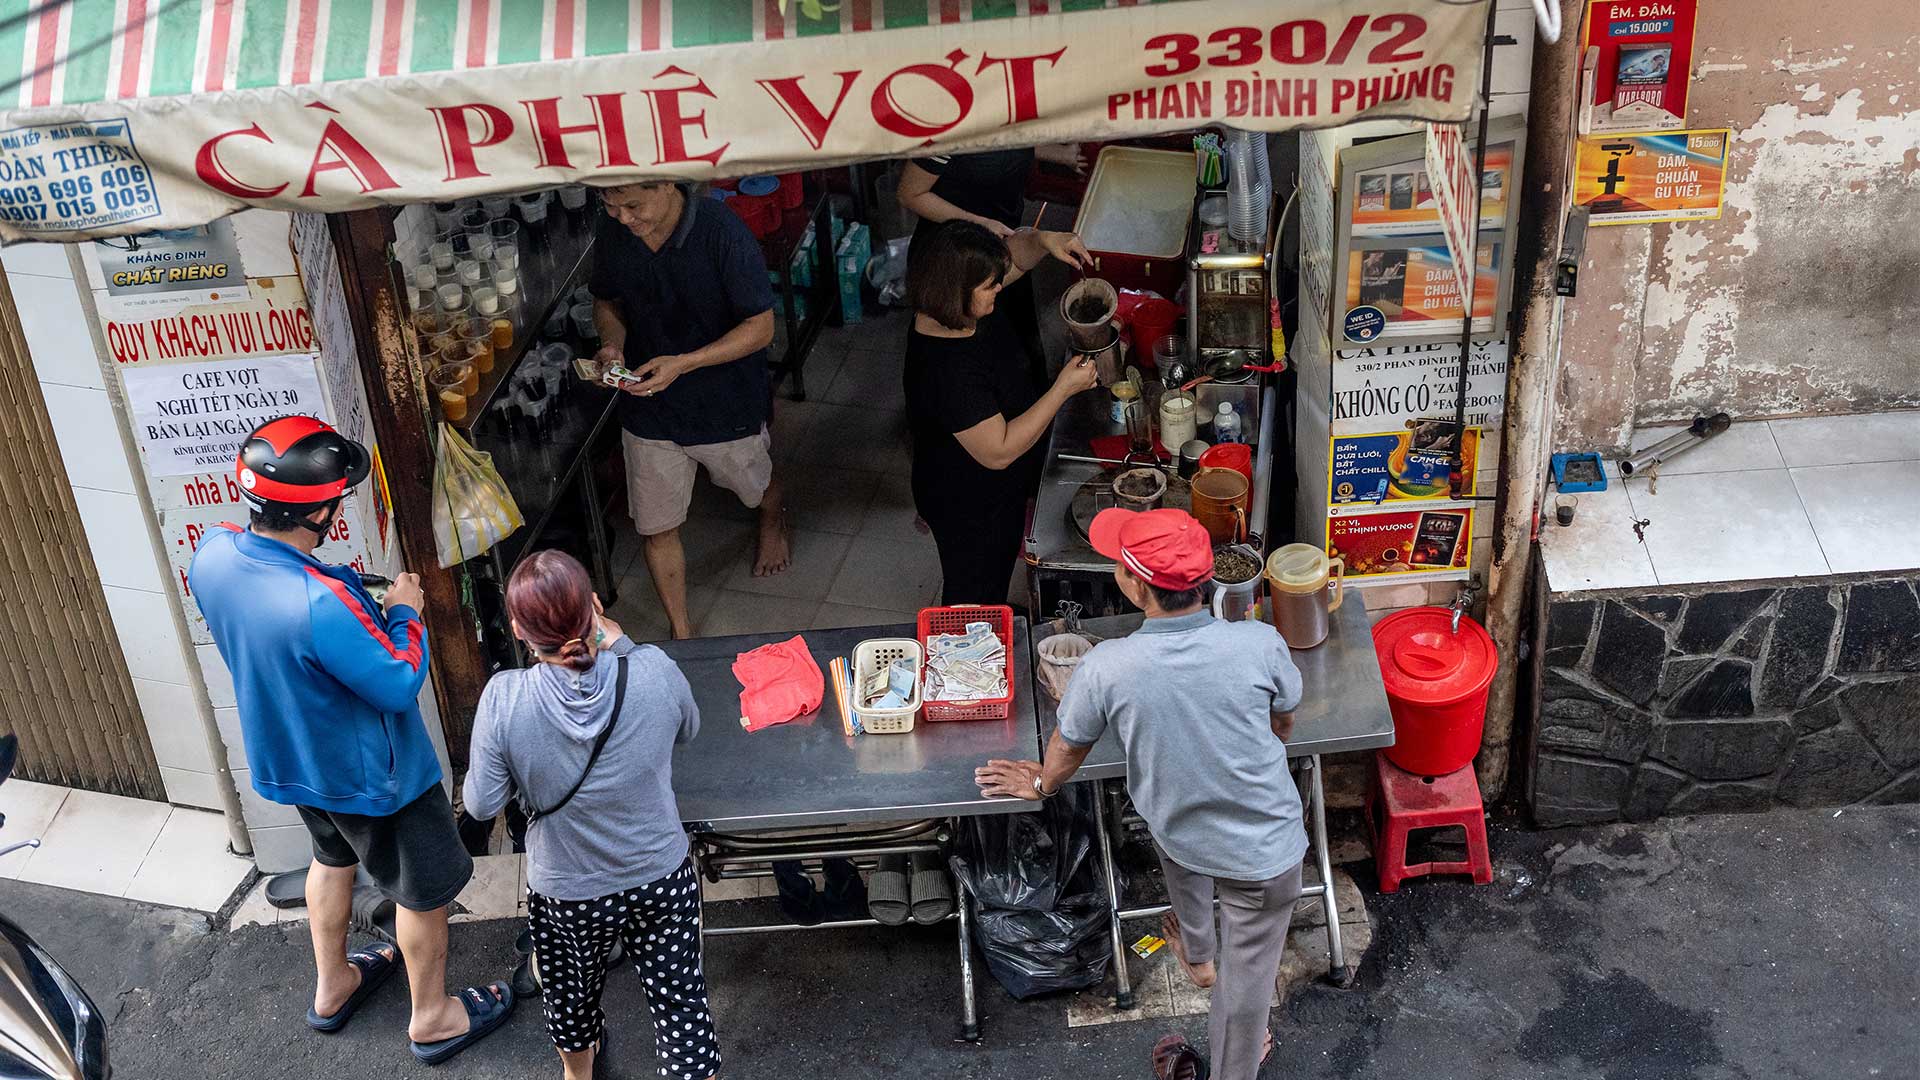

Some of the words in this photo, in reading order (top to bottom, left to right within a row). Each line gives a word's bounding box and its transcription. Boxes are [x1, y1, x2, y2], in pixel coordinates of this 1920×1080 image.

[1610, 5, 1635, 19] ÊM.
[1639, 2, 1676, 19] ĐẬM.
[1144, 13, 1428, 78] 330/2
[1108, 86, 1212, 121] PHAN
[1225, 71, 1317, 118] ĐÌNH
[1331, 63, 1455, 115] PHÙNG
[1617, 89, 1662, 108] MARLBORO
[195, 101, 402, 199] CÀ
[427, 65, 730, 182] PHÊ
[755, 46, 1068, 150] VỢT
[1658, 153, 1689, 170] ĐẬM.
[48, 176, 93, 200] 696
[101, 165, 145, 189] 406
[1655, 186, 1672, 199] GU
[1675, 183, 1702, 199] VIỆT
[56, 196, 97, 218] 015
[104, 184, 151, 211] 005
[168, 262, 228, 282] RIÊNG
[1424, 299, 1440, 309] GU
[1443, 296, 1461, 309] VIỆ
[220, 309, 258, 354] VUI
[256, 298, 313, 352] LÒNG
[1355, 362, 1381, 373] 330/2
[1384, 358, 1416, 370] PHAN
[1418, 355, 1447, 367] ĐÌNH
[1451, 353, 1491, 363] PNG
[182, 371, 224, 390] CAFE
[226, 367, 260, 389] VỢT
[156, 393, 199, 417] NGHỈ
[200, 390, 230, 412] TẾT
[231, 387, 279, 411] NGÀY
[283, 389, 299, 406] 30
[1334, 378, 1400, 420] KHÔNG
[1405, 374, 1430, 414] CÓ
[147, 419, 181, 441] BÁN
[184, 421, 209, 441] LẠI
[210, 413, 258, 436] NGÀY
[173, 443, 195, 456] KÍNH
[195, 442, 220, 454] CHÚC
[220, 440, 237, 453] QUÝ
[194, 456, 209, 466] AN
[208, 453, 236, 465] KHANG
[1410, 455, 1449, 466] CAMEL
[1361, 466, 1386, 474] CHILL
[184, 473, 223, 506] nhà
[224, 473, 240, 504] b
[1348, 525, 1377, 535] THỊNH
